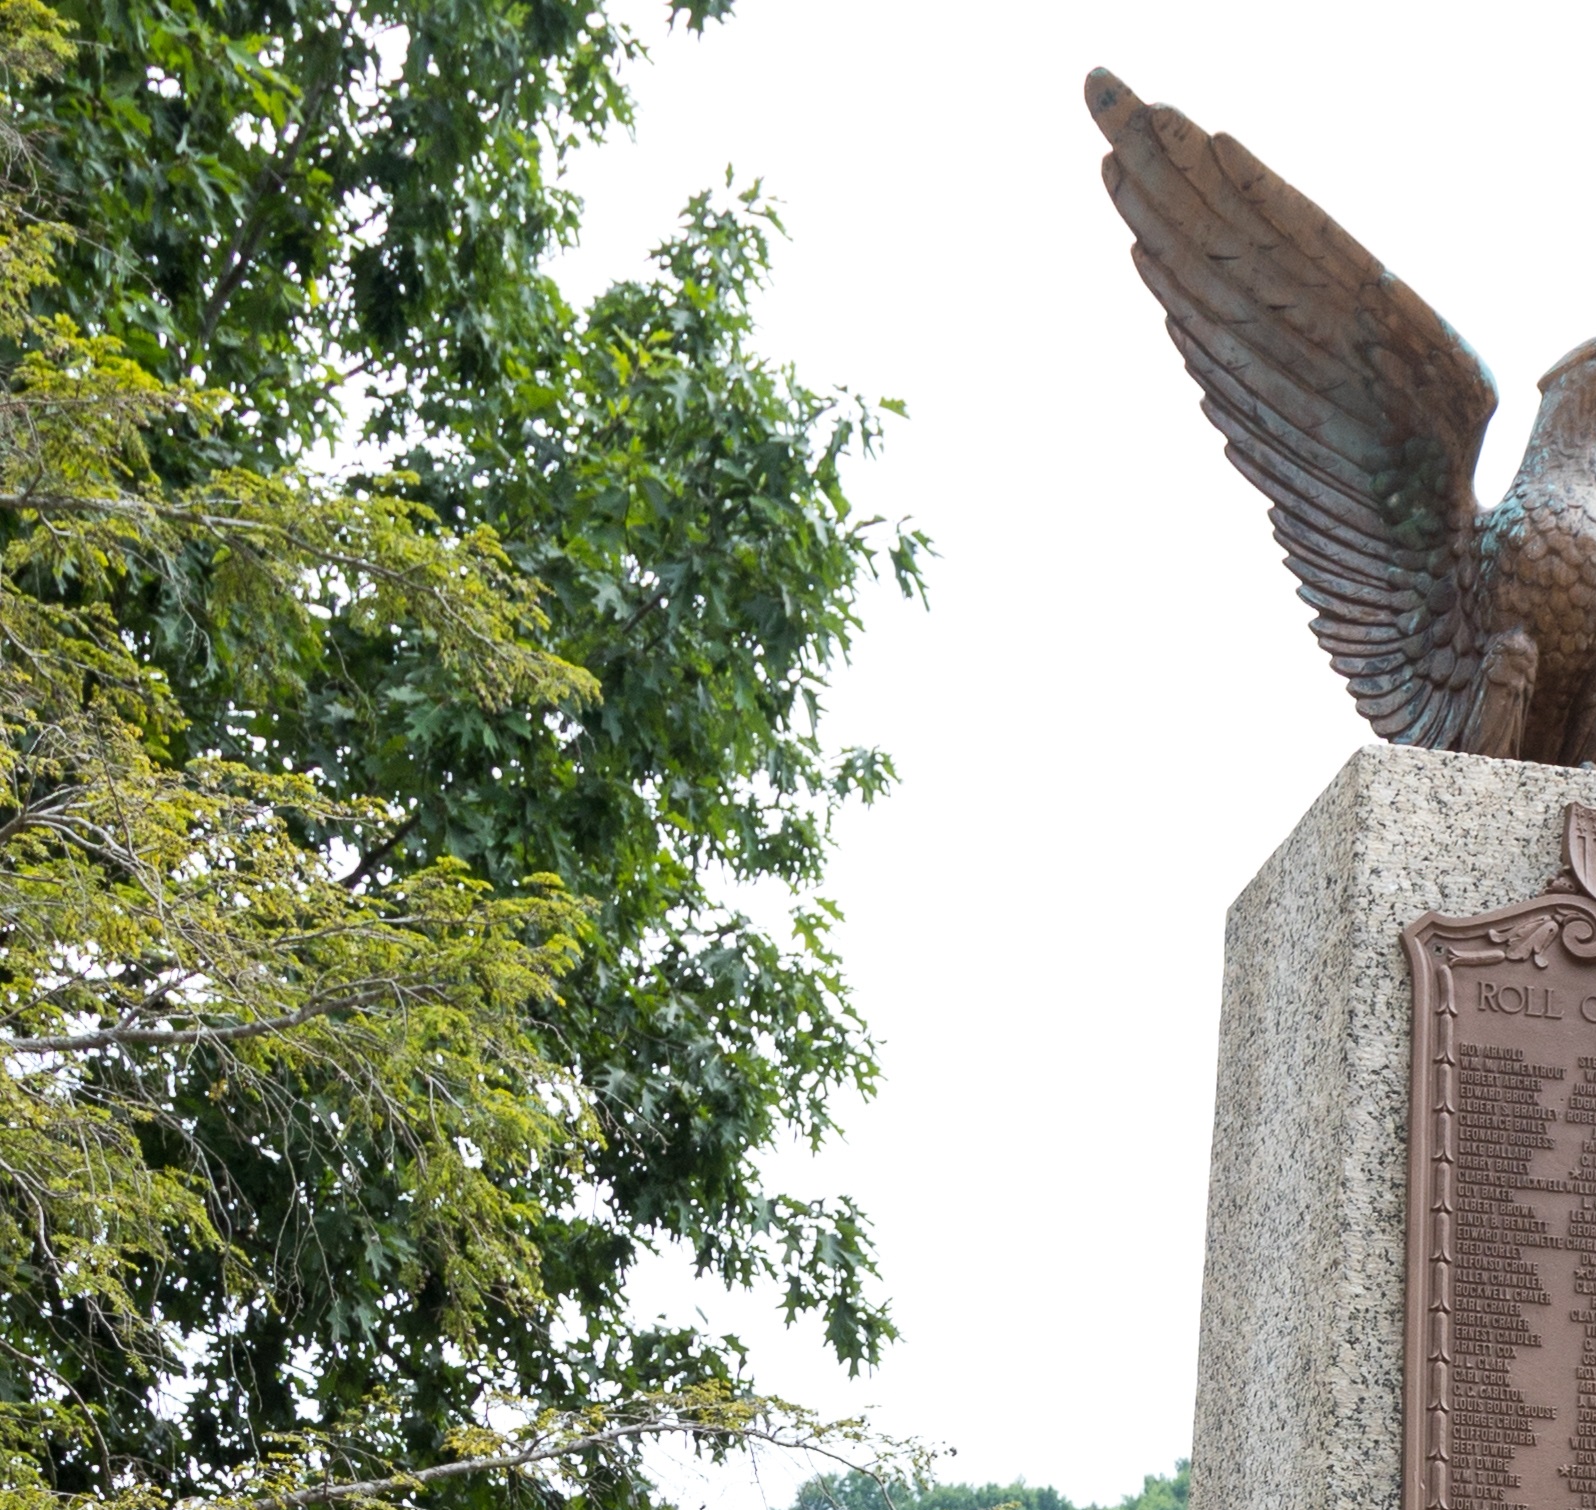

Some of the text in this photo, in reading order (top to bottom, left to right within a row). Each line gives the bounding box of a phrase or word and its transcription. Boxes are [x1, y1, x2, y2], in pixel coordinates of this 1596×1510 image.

[1476, 980, 1564, 1020] ROLL
[1460, 1070, 1543, 1091] ROBERT ARCHER
[1457, 1112, 1547, 1134] CLARENCE BAILEY
[1459, 1127, 1555, 1149] LEONARD BOGGESS
[1458, 1141, 1533, 1161] LAKE BALLARD
[1458, 1155, 1530, 1174] HARRY BAILEY
[1456, 1183, 1514, 1201] GUY BAKER
[1456, 1197, 1536, 1218] ALBERT BROWN
[1456, 1240, 1521, 1259] FRED CORLEY
[1455, 1254, 1538, 1274] ALFONSO CRONE
[1455, 1283, 1551, 1304] ROCKWELL CRAVER
[1490, 1315, 1529, 1331] CRAVER
[1455, 1326, 1542, 1346] ERNEST CANDLER
[1454, 1340, 1517, 1358] ARNETT COX
[1452, 1412, 1532, 1431] GEORGE CRUISE
[1452, 1440, 1515, 1458] BERT DWIRE
